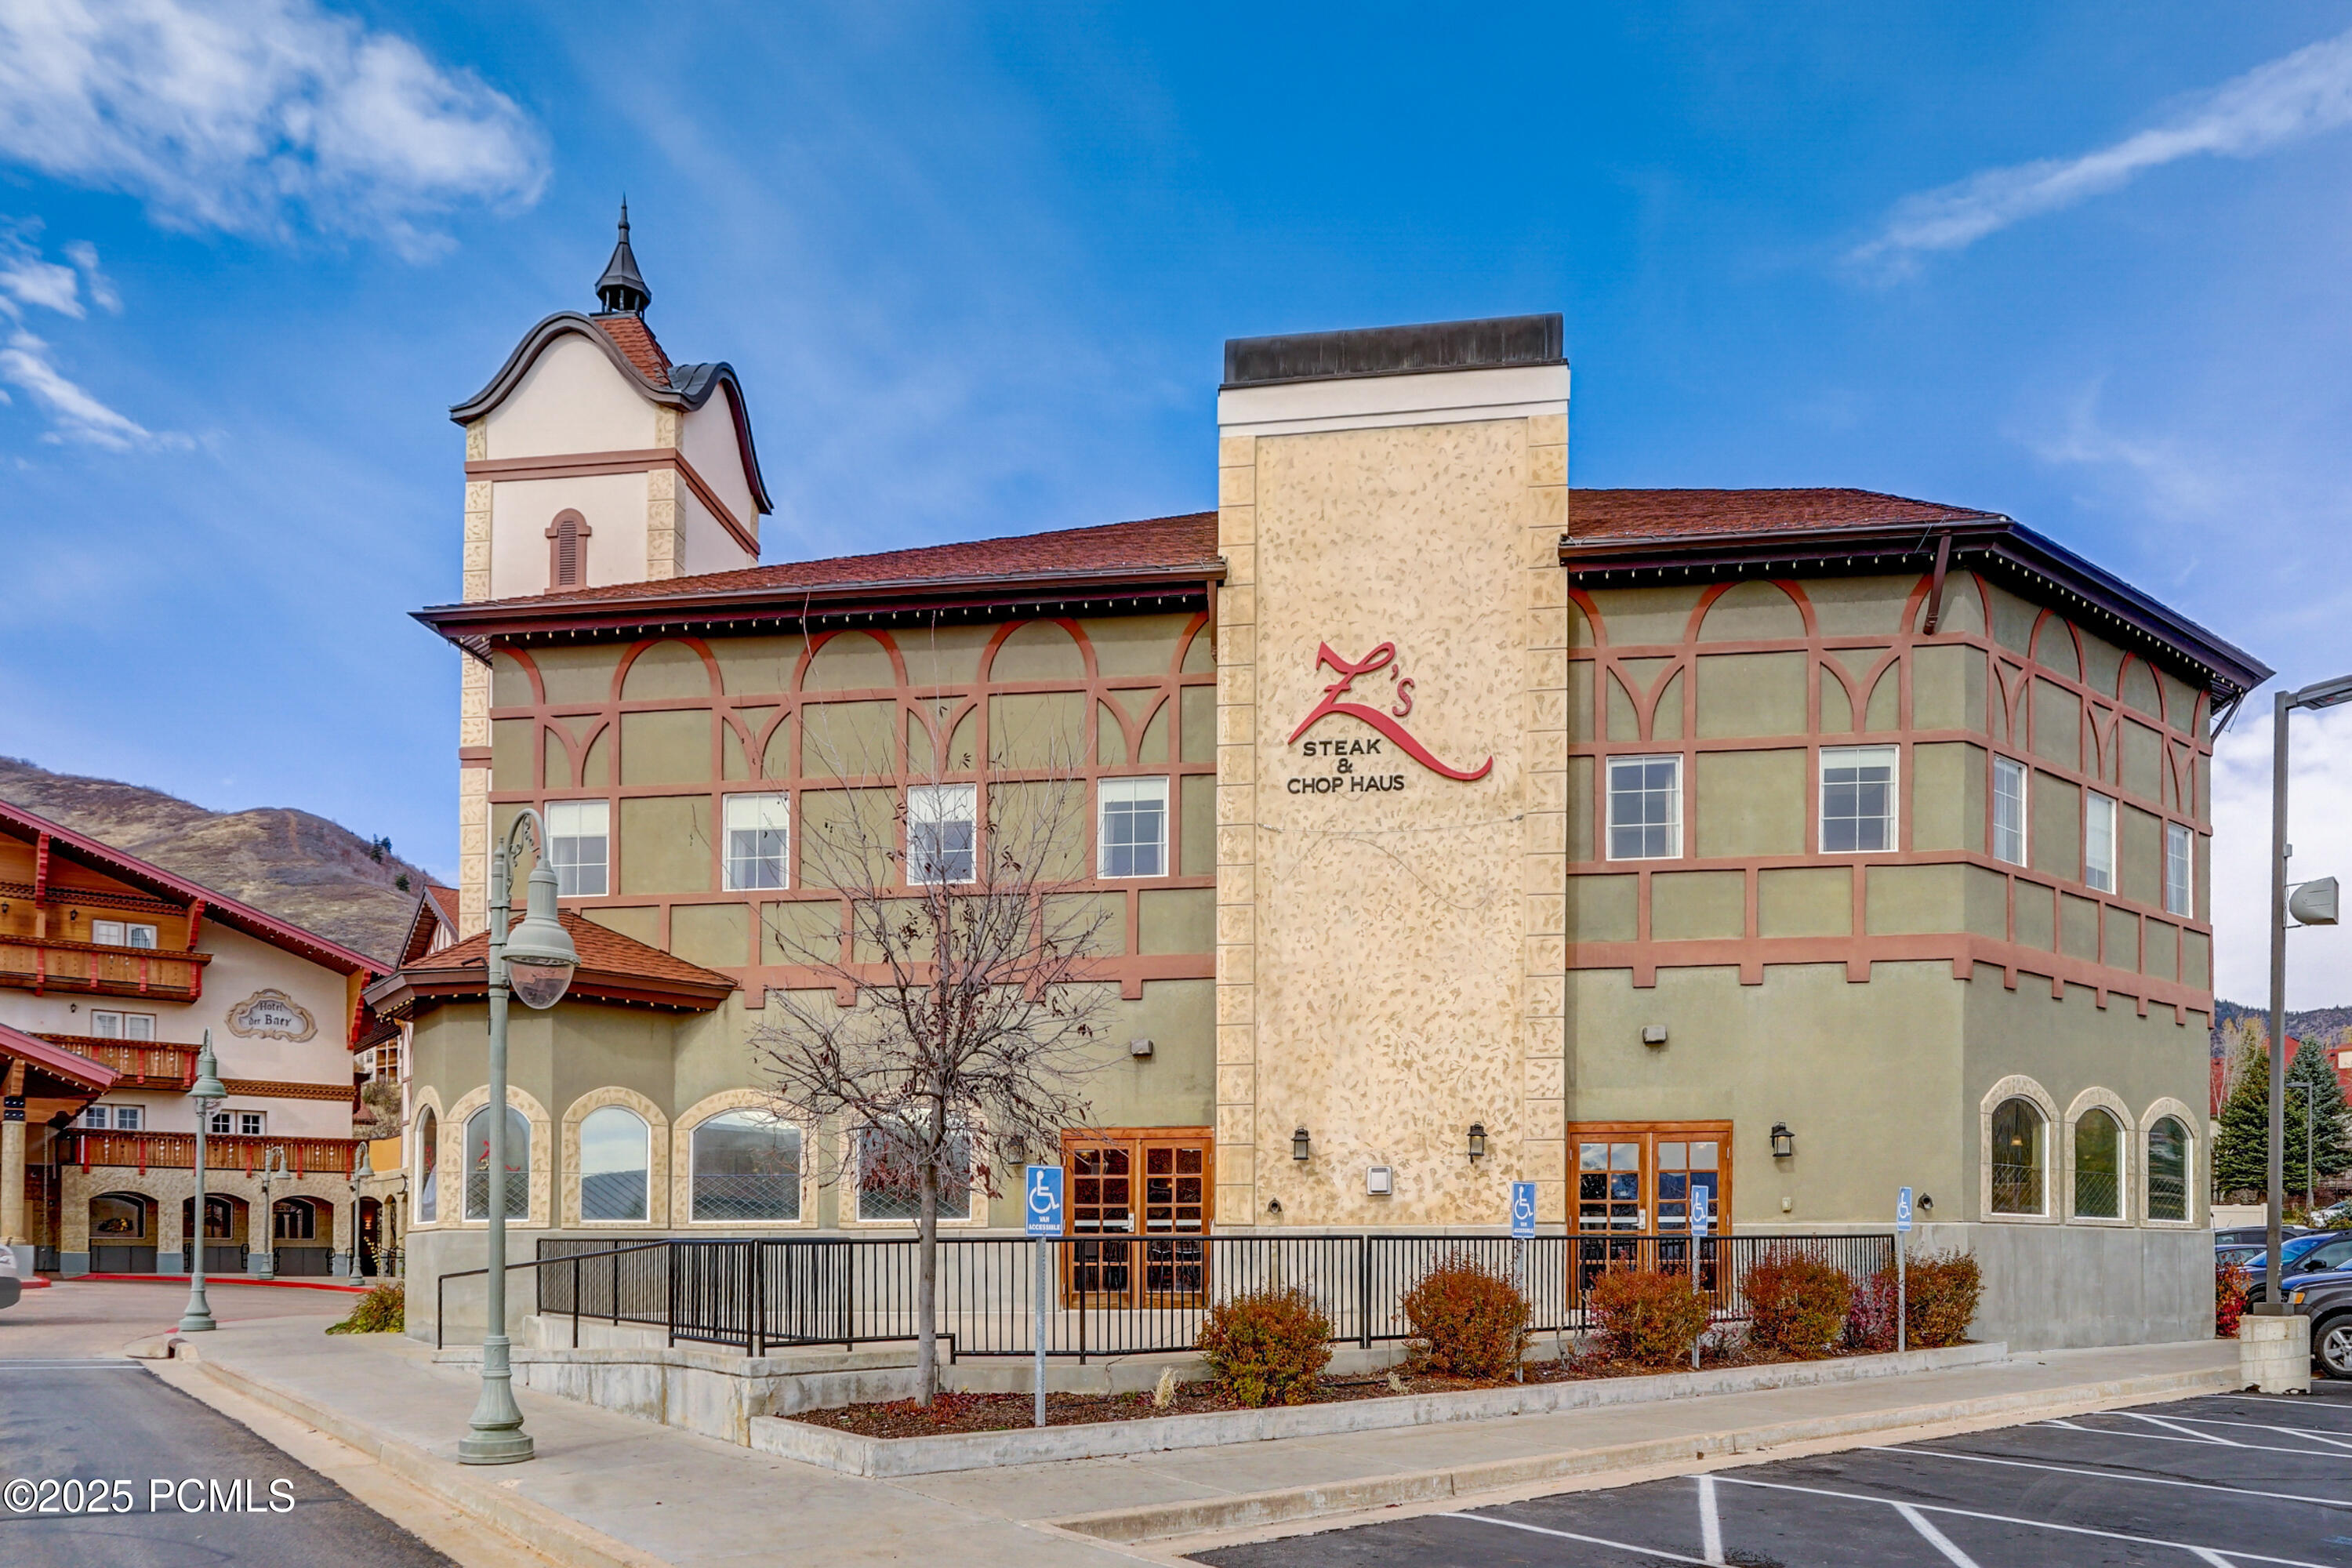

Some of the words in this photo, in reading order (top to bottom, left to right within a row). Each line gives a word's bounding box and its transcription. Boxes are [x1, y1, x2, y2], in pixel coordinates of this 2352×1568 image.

[1302, 738, 1382, 757] STEAK
[1337, 758, 1353, 774] &
[1287, 777, 1344, 794] CHOP
[1350, 775, 1405, 793] HAUS
